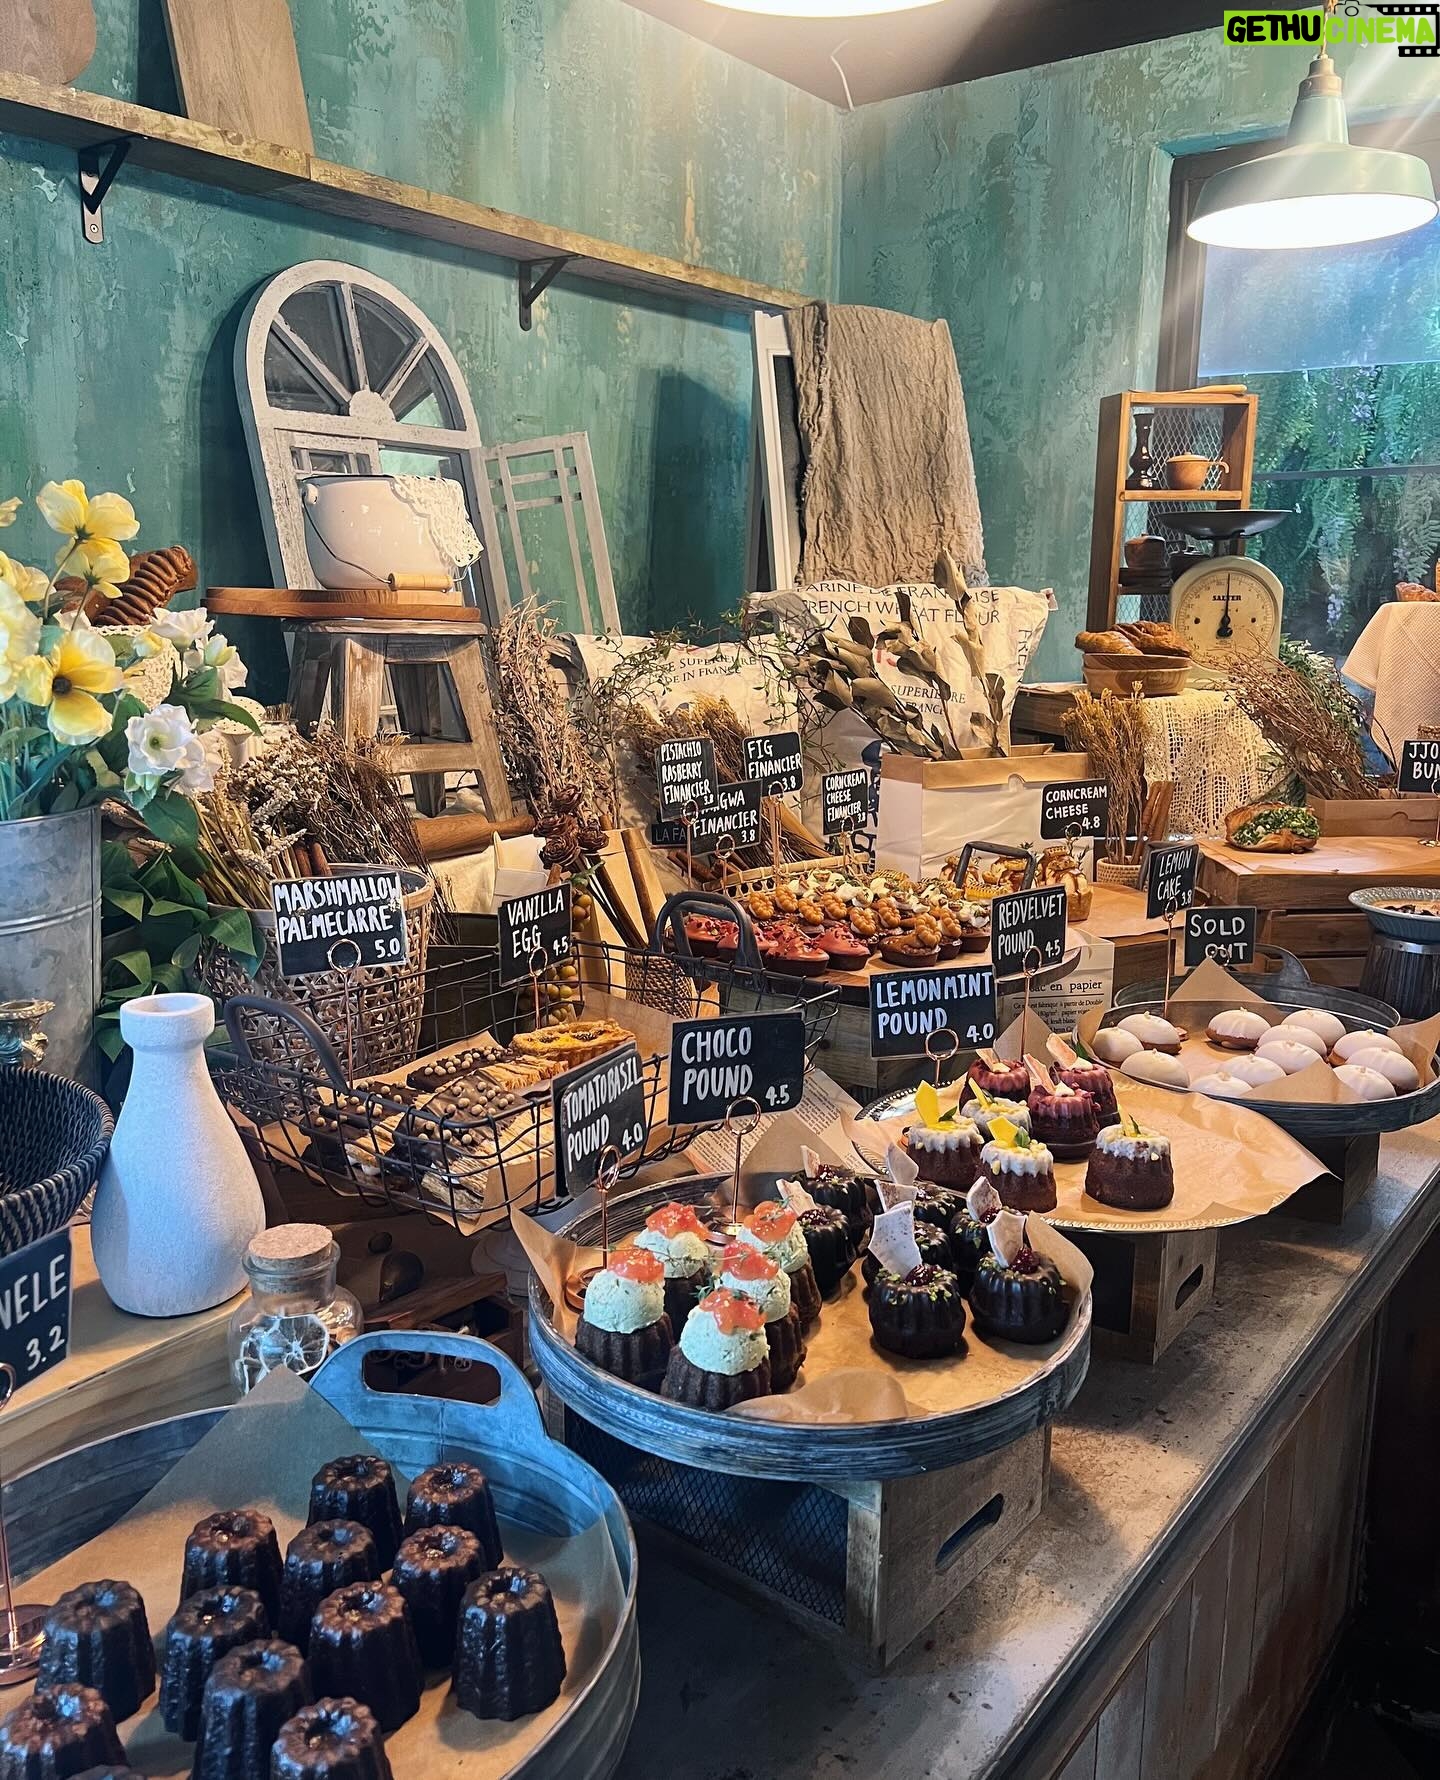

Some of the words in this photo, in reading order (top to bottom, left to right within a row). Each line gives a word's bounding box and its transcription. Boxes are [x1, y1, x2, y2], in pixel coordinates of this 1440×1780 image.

[797, 583, 865, 592] ARINE
[945, 608, 1001, 625] FLUR
[683, 670, 695, 681] IN
[891, 685, 966, 704] SUPERIERE
[661, 741, 702, 762] PISTACHIO
[747, 739, 773, 759] FIG
[661, 761, 703, 784] RASBERRY
[748, 752, 803, 779] FINANCIER
[663, 778, 711, 805] FINANCIER
[782, 775, 796, 792] 3.8
[825, 771, 866, 791] CORNCREAM
[703, 793, 715, 806] 3.8
[826, 788, 852, 805] CHEESE
[1045, 785, 1107, 803] CORNCREAM
[827, 800, 862, 823] FINANCIER
[1045, 803, 1089, 820] CHEESE
[1081, 815, 1101, 830] 4.8
[693, 809, 758, 838] FINANCIER
[740, 829, 756, 843] 3.8
[1159, 848, 1193, 877] LEMON
[274, 876, 401, 915] MARSHMALLOW
[1157, 874, 1182, 901] CAKE
[1181, 889, 1193, 906] 3.8
[507, 889, 565, 927] VANILLA
[998, 893, 1065, 931] REDVELVET
[278, 904, 394, 945] PALMECARRE
[1190, 914, 1246, 937] SOLD
[374, 937, 401, 959] 5.0
[512, 924, 542, 959] EGG
[553, 935, 569, 957] 4.5
[998, 928, 1035, 961] POUND
[1045, 939, 1061, 958] 4.5
[1050, 983, 1063, 992] en
[1069, 979, 1102, 993] papier
[878, 1007, 948, 1039] POUND
[966, 1023, 994, 1043] 4.0
[681, 1026, 752, 1064] CHOCO
[564, 1056, 643, 1129] TOMATOBASIL
[682, 1064, 753, 1105] POUND
[765, 1084, 790, 1106] 4.5
[567, 1113, 610, 1172] POUND
[621, 1122, 643, 1151] 4.0
[26, 1325, 65, 1371] 3.2
